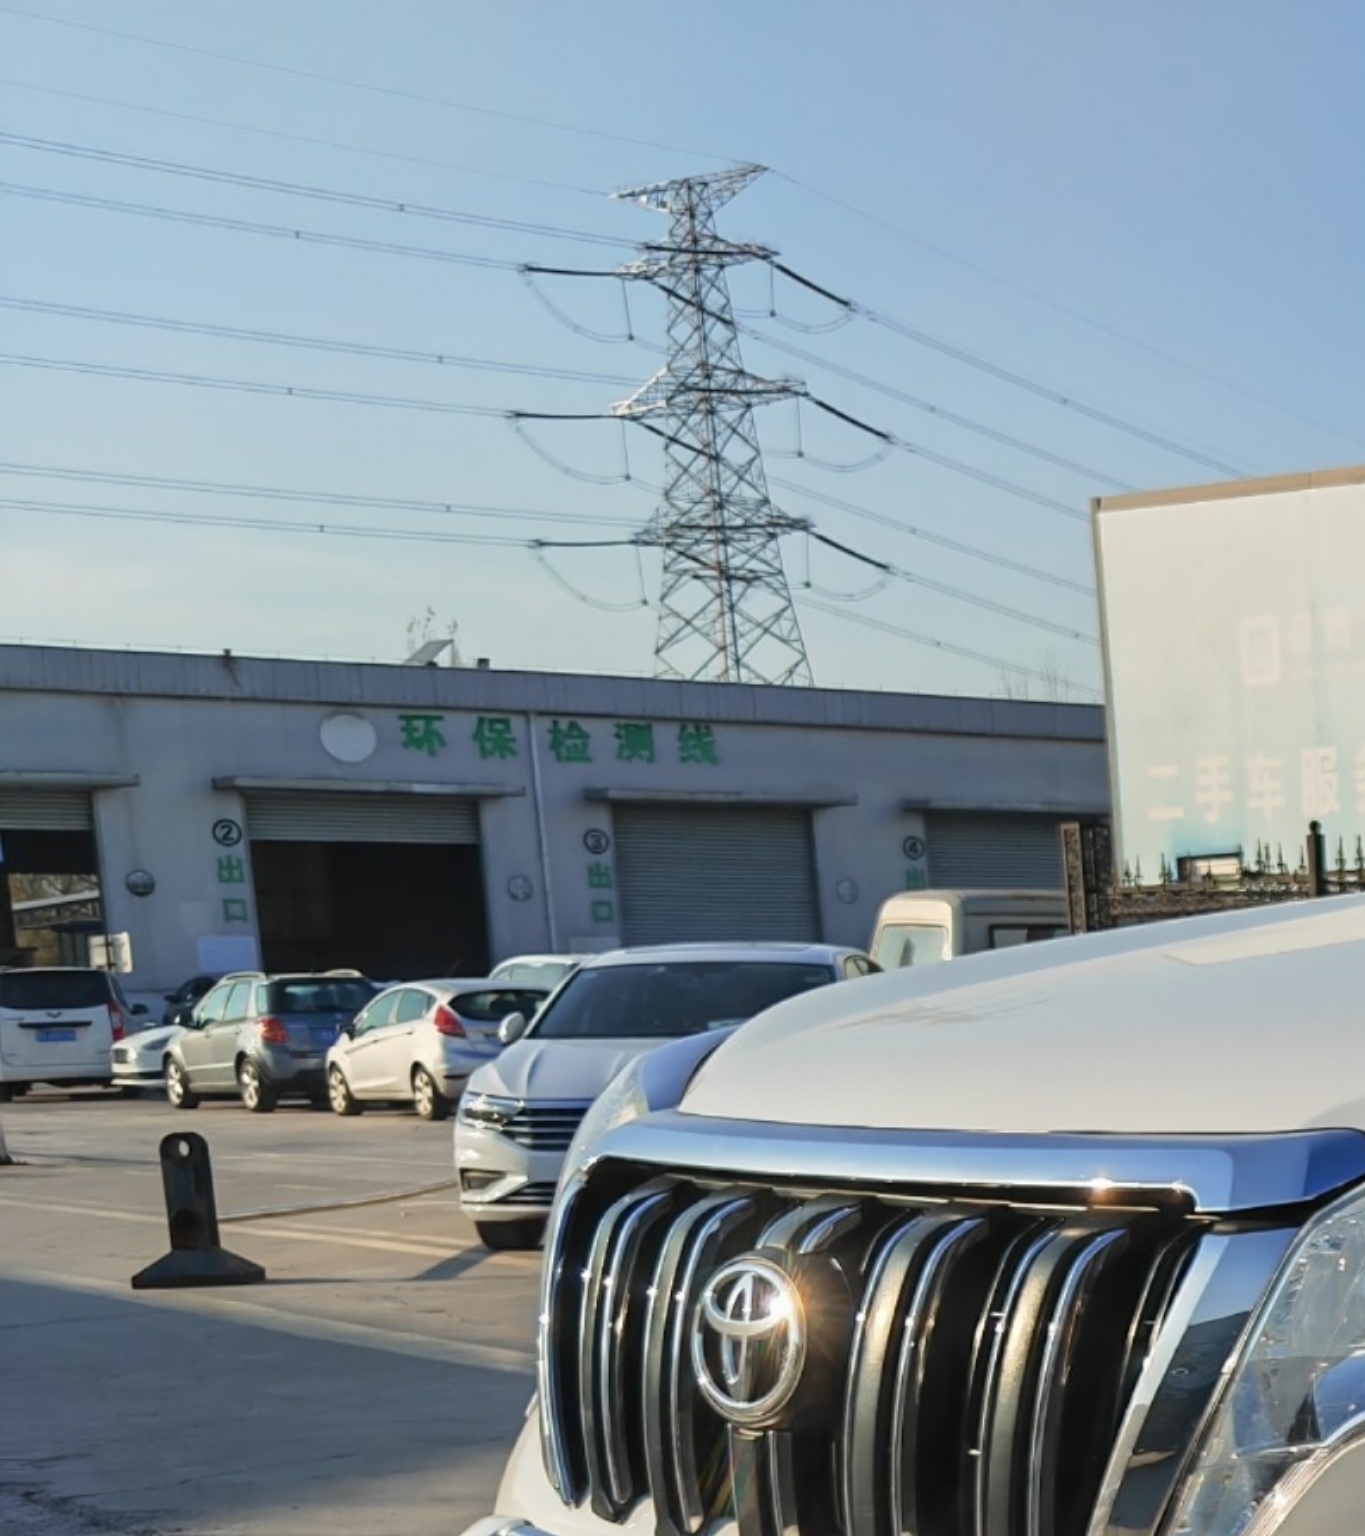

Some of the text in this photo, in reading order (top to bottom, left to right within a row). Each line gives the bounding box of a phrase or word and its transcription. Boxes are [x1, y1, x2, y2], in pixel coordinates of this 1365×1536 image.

[398, 714, 721, 766] 环保检测线
[217, 855, 247, 922] 出口
